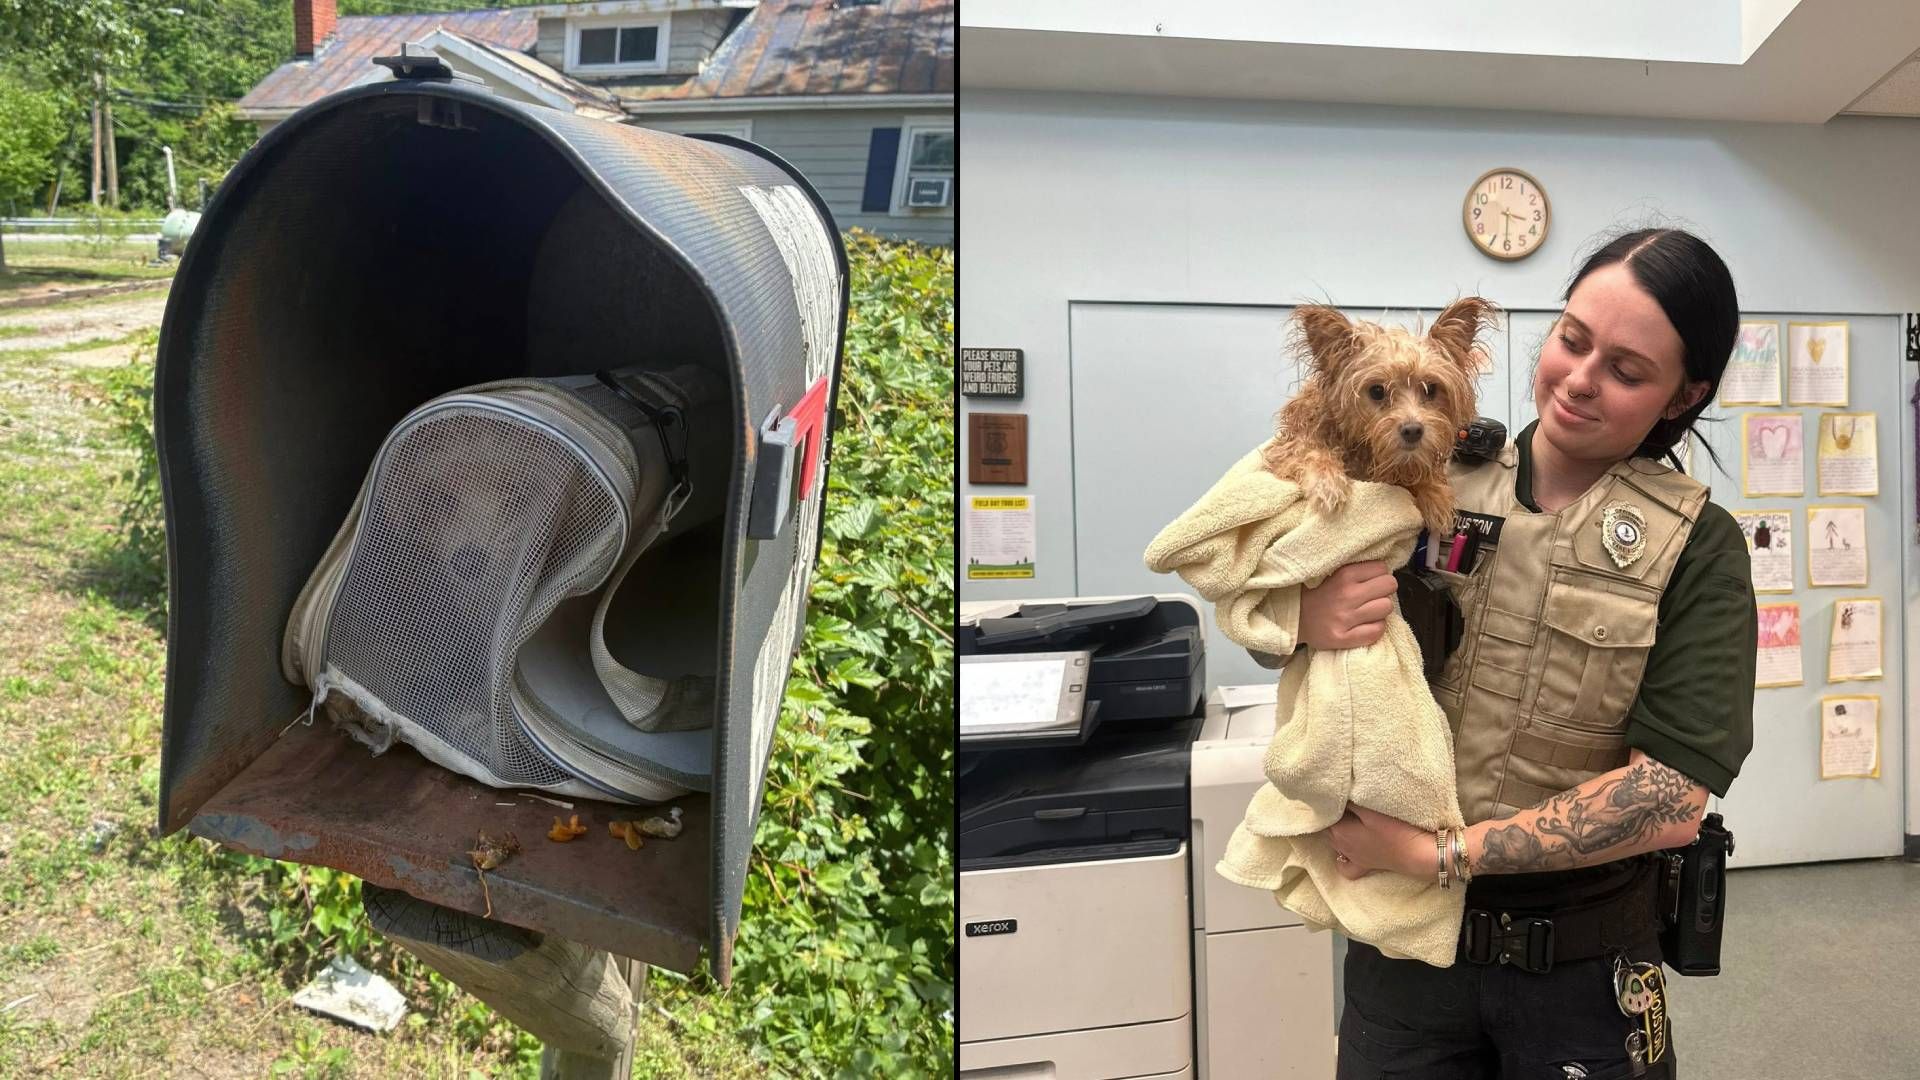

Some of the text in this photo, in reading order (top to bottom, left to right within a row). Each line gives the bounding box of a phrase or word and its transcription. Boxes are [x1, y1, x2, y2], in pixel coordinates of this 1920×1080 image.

[1488, 182, 1497, 194] 11
[1500, 176, 1513, 190] 12
[1520, 183, 1524, 195] 1
[1476, 193, 1488, 205] 10
[1529, 194, 1537, 206] 2
[1473, 208, 1482, 220] 9
[1533, 210, 1541, 222] 3
[1476, 223, 1485, 235] 8
[1528, 224, 1537, 236] 4
[1503, 240, 1511, 251] 6
[1518, 235, 1526, 247] 5
[963, 350, 1017, 361] PLEASE NEUTER
[963, 361, 1017, 372] YOUR PETS AND
[963, 371, 1017, 383] WEIRD FRIENDS
[963, 382, 1017, 394] AND RELATIVES
[1452, 515, 1494, 535] OUSTON
[973, 922, 1009, 934] xerox
